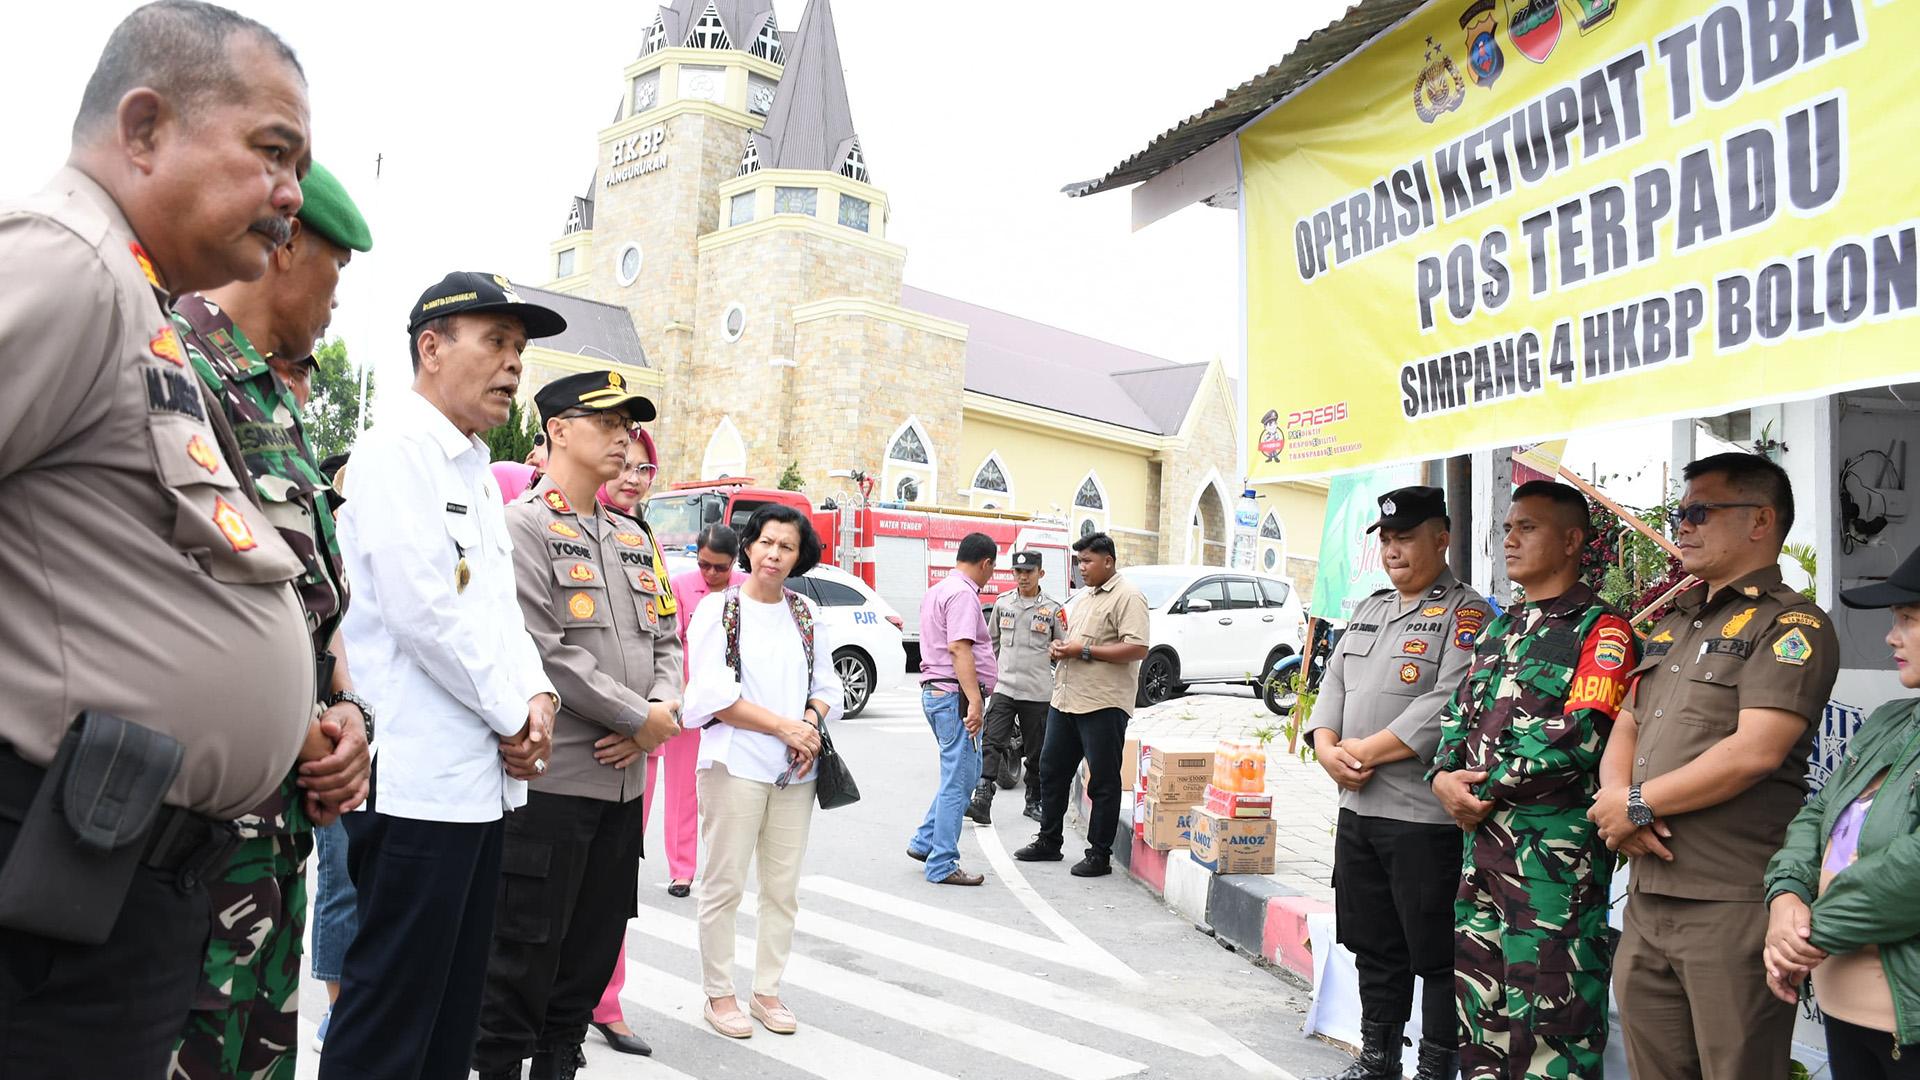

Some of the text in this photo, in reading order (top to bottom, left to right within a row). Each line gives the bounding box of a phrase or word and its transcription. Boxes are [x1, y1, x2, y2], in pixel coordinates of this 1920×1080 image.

[612, 127, 666, 167] HKBP
[1295, 0, 1859, 280] OPERASI KETUPAT TOBA
[604, 154, 668, 187] PANGURURAN
[1418, 97, 1840, 330] POS TERPADU
[1401, 227, 1918, 417] SIMPANG 4 HKBP BOLON
[1287, 402, 1348, 429] PRESISI
[880, 519, 922, 531] WATER TENDER
[552, 542, 592, 559] YOGIE
[854, 611, 878, 625] PJR
[1405, 622, 1442, 633] POLRI
[1193, 831, 1211, 849] AMOZ
[1229, 836, 1265, 845] AMOZ
